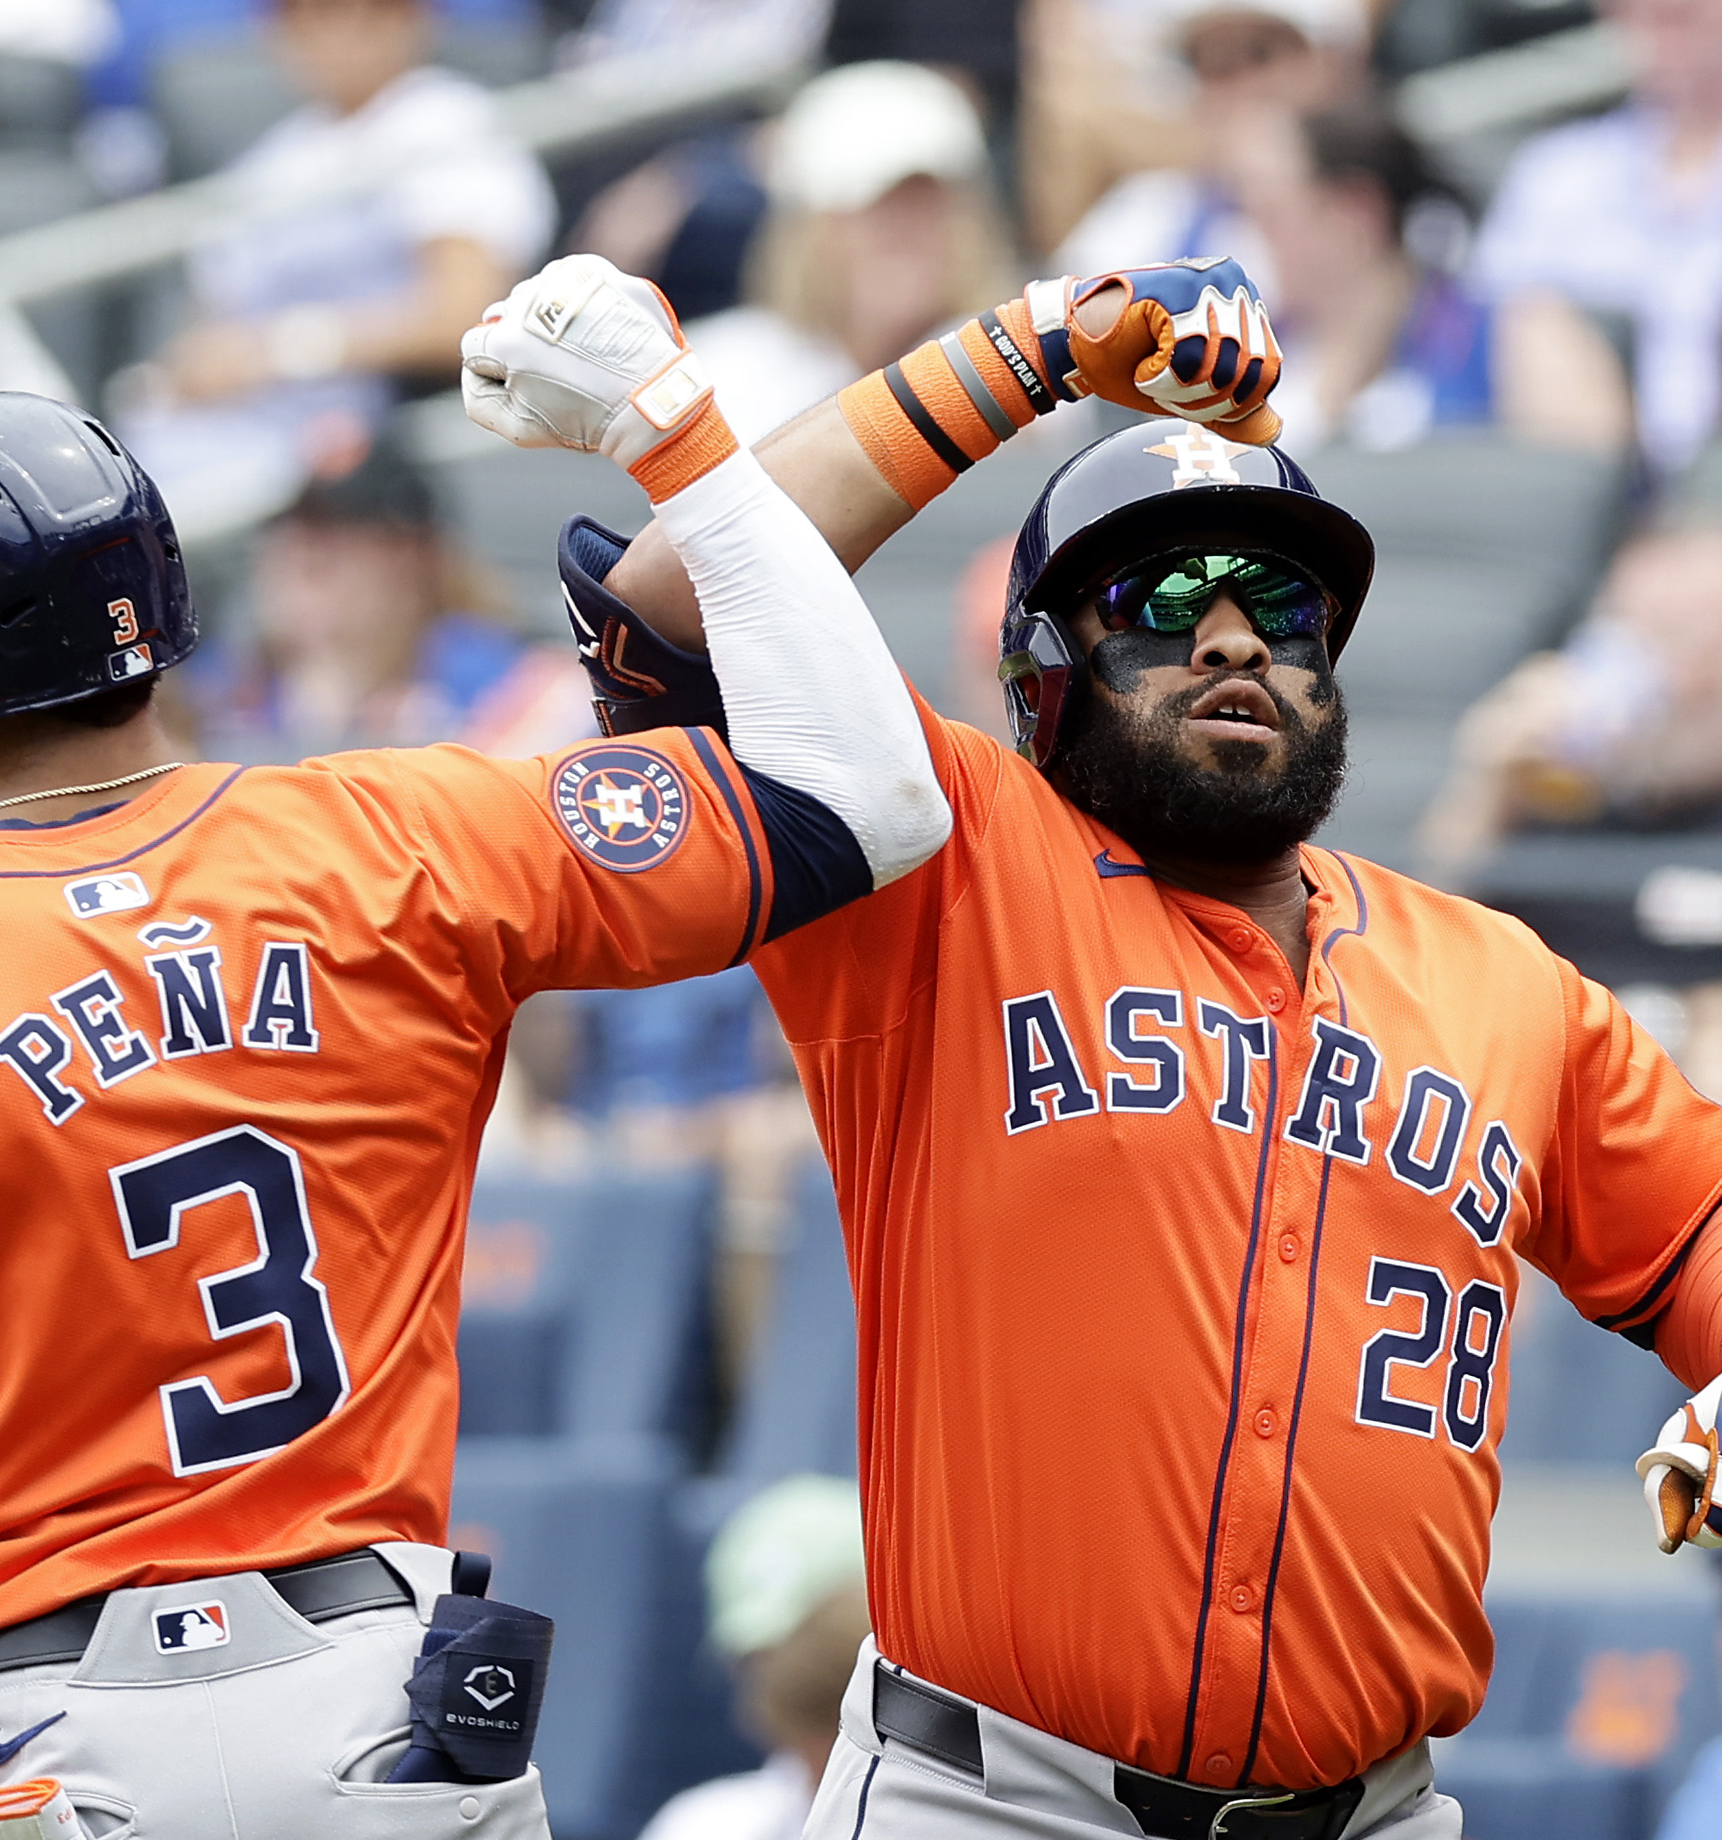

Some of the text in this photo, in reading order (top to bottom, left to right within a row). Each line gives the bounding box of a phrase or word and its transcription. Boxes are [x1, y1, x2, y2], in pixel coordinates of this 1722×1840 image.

[995, 335, 1037, 388] GOD'S PLAN
[107, 597, 139, 645] 3
[559, 761, 600, 849] HOUSTON
[595, 783, 646, 828] H
[643, 762, 681, 849] ASTROS
[1002, 985, 1522, 1248] ASTROS
[108, 1123, 352, 1478] 3
[1355, 1255, 1507, 1452] 28
